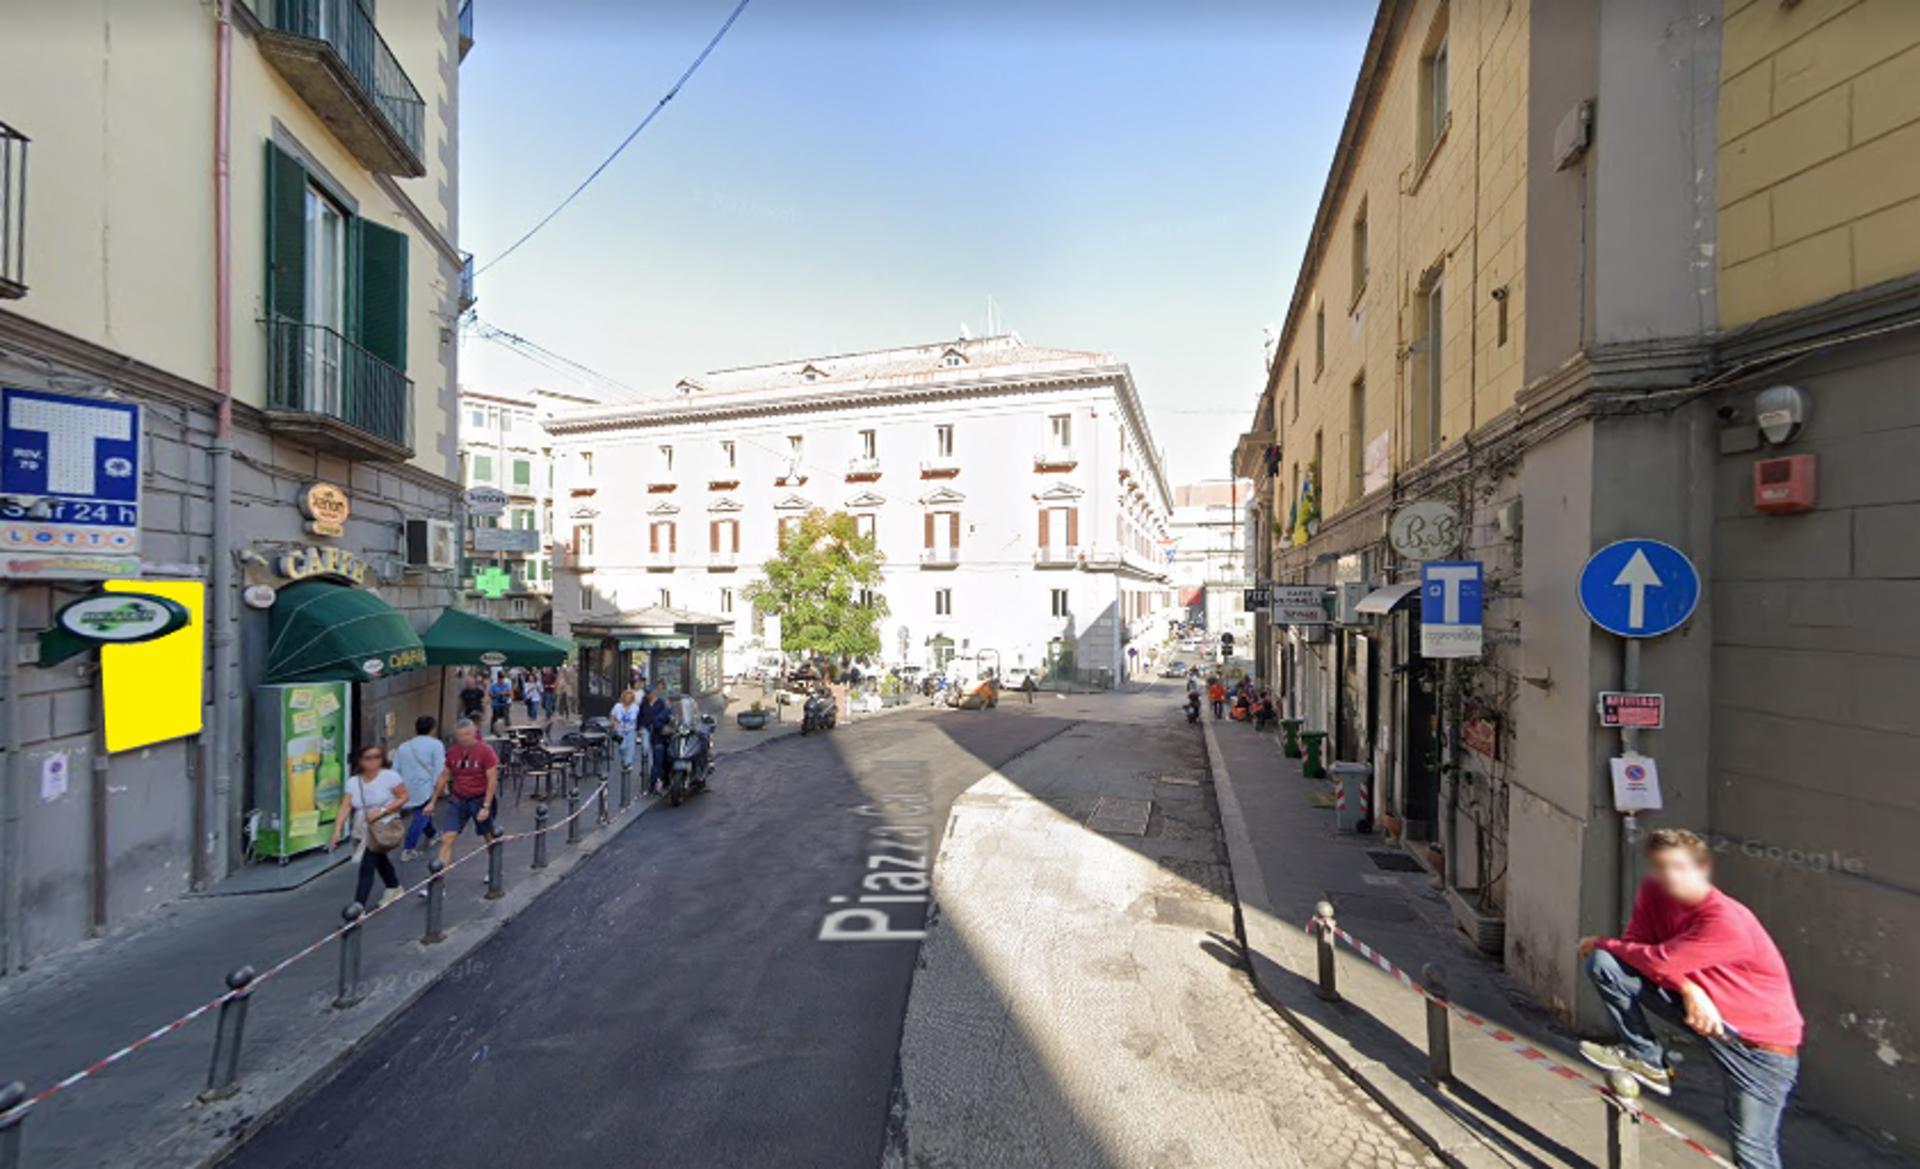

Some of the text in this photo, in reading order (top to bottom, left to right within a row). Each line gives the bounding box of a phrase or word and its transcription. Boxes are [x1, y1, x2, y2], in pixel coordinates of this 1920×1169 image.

[9, 396, 131, 495] T
[74, 504, 108, 521] 24
[1427, 566, 1477, 623] T
